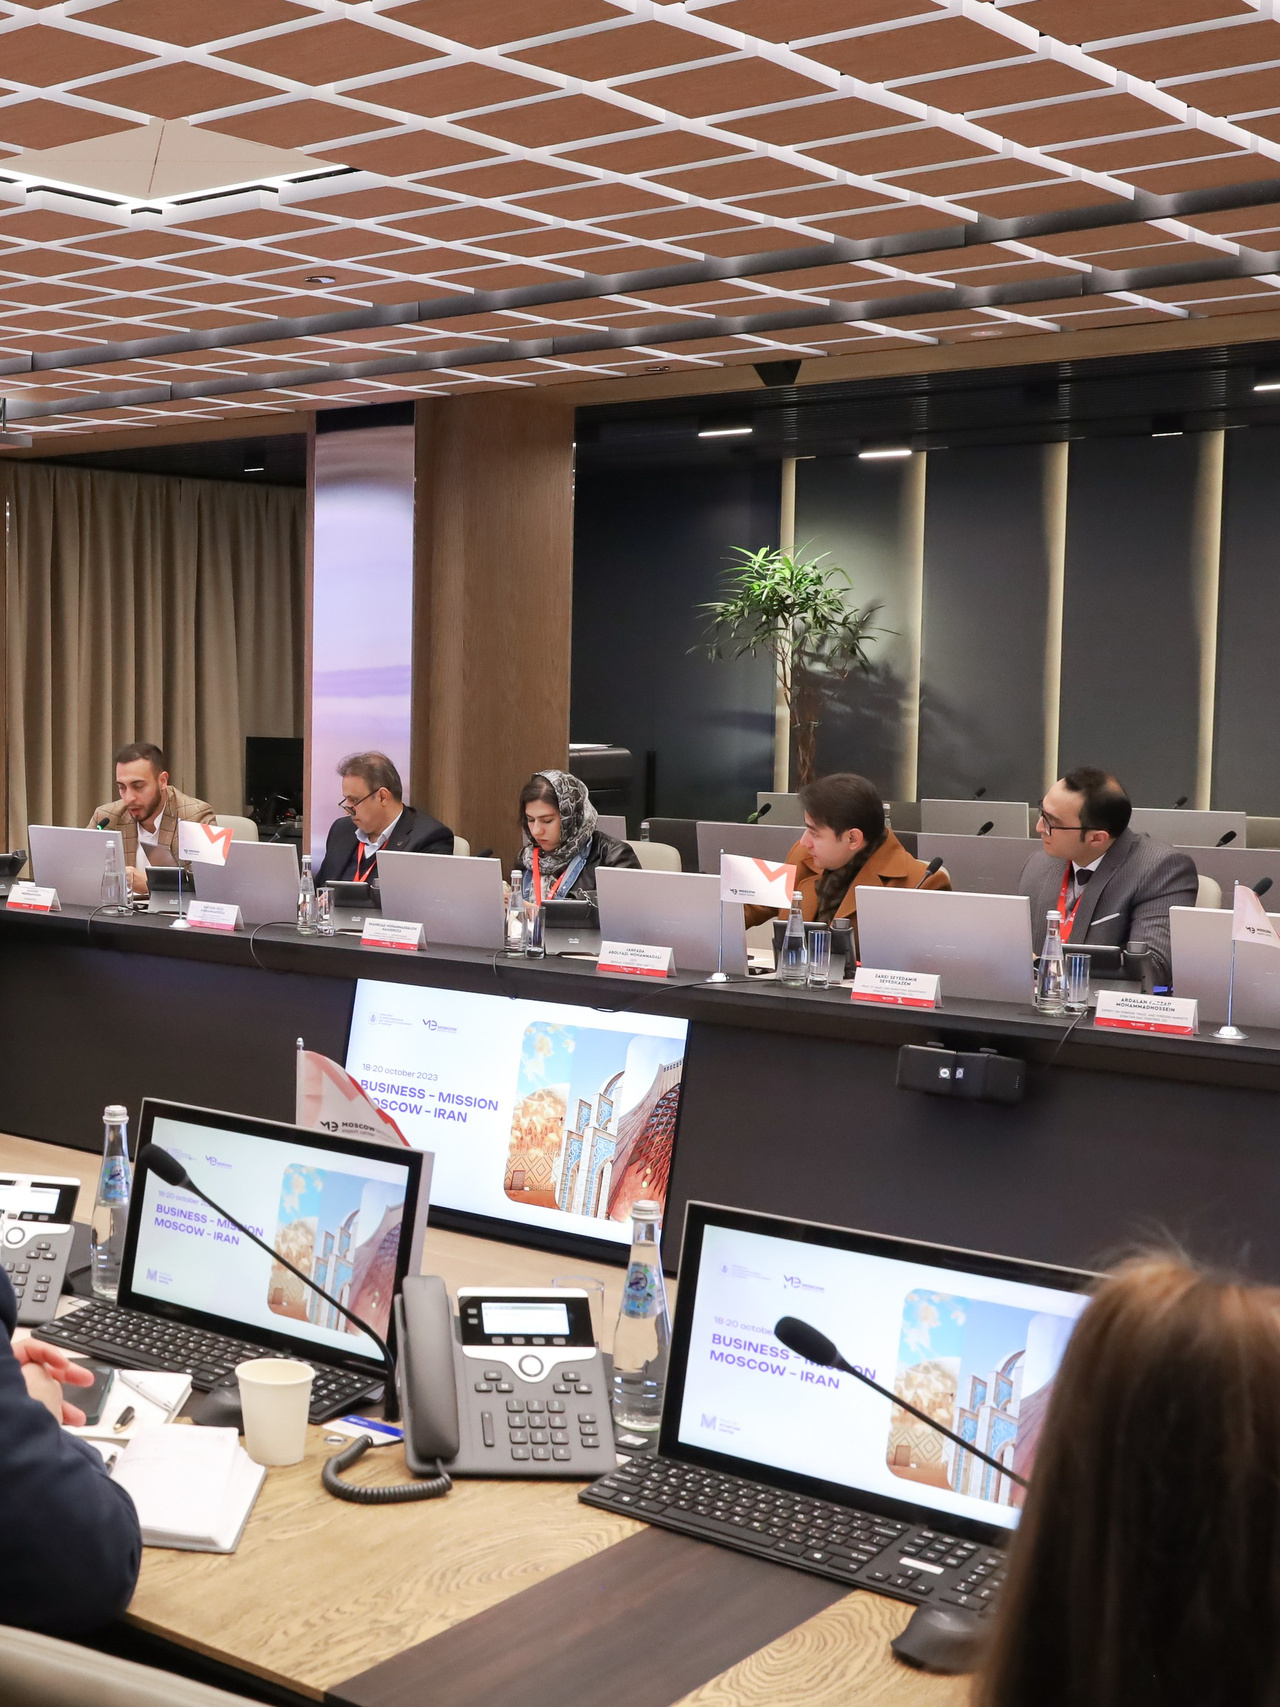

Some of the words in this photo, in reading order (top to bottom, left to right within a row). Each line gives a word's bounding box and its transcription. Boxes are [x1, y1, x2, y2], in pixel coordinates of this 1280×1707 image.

[1116, 1002, 1176, 1012] MOHAMMADHOSSEIN
[385, 1067, 416, 1078] october
[417, 1072, 439, 1082] 2023
[361, 1080, 426, 1100] BUSINESS
[438, 1092, 499, 1111] MISSION
[372, 1098, 423, 1115] OSCOW
[434, 1108, 468, 1123] IRAN
[342, 1122, 376, 1132] MOSCOW
[156, 1204, 208, 1223] BUSINESS
[154, 1217, 205, 1237] MOSCOW
[214, 1232, 240, 1245] IRAN
[740, 1323, 773, 1335] octobe
[712, 1333, 790, 1360] BUSINESS
[710, 1350, 787, 1377] MOSCOW
[801, 1371, 840, 1389] IRAN
